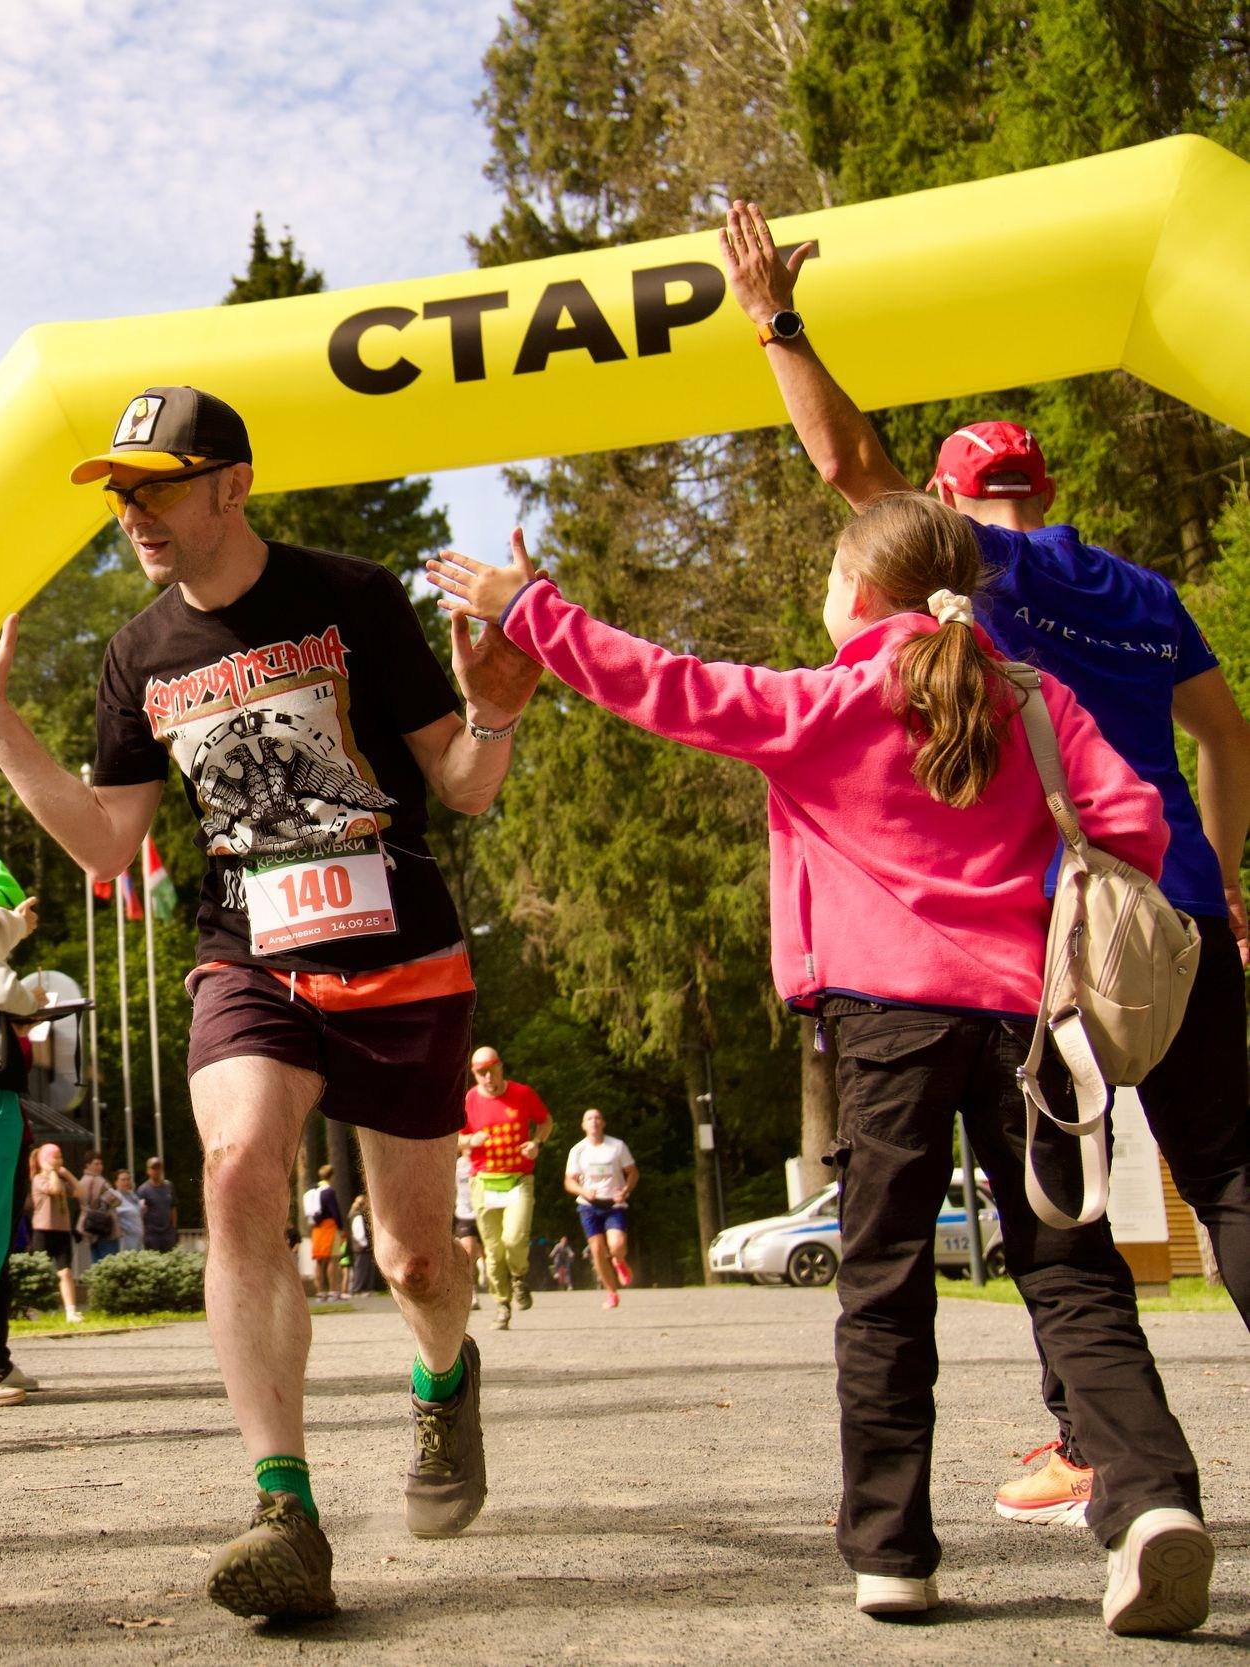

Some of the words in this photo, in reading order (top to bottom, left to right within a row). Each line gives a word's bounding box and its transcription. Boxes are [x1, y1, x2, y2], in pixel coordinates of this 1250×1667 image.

[328, 239, 820, 396] СТАР
[313, 685, 334, 701] 1L
[256, 847, 308, 869] КРОСС
[312, 838, 366, 858] ДУБКИ
[277, 864, 353, 917] 140
[268, 926, 321, 946] Апрелевка
[330, 916, 380, 932] 14.09.25
[945, 1236, 970, 1251] 112
[1071, 1477, 1092, 1496] HO
